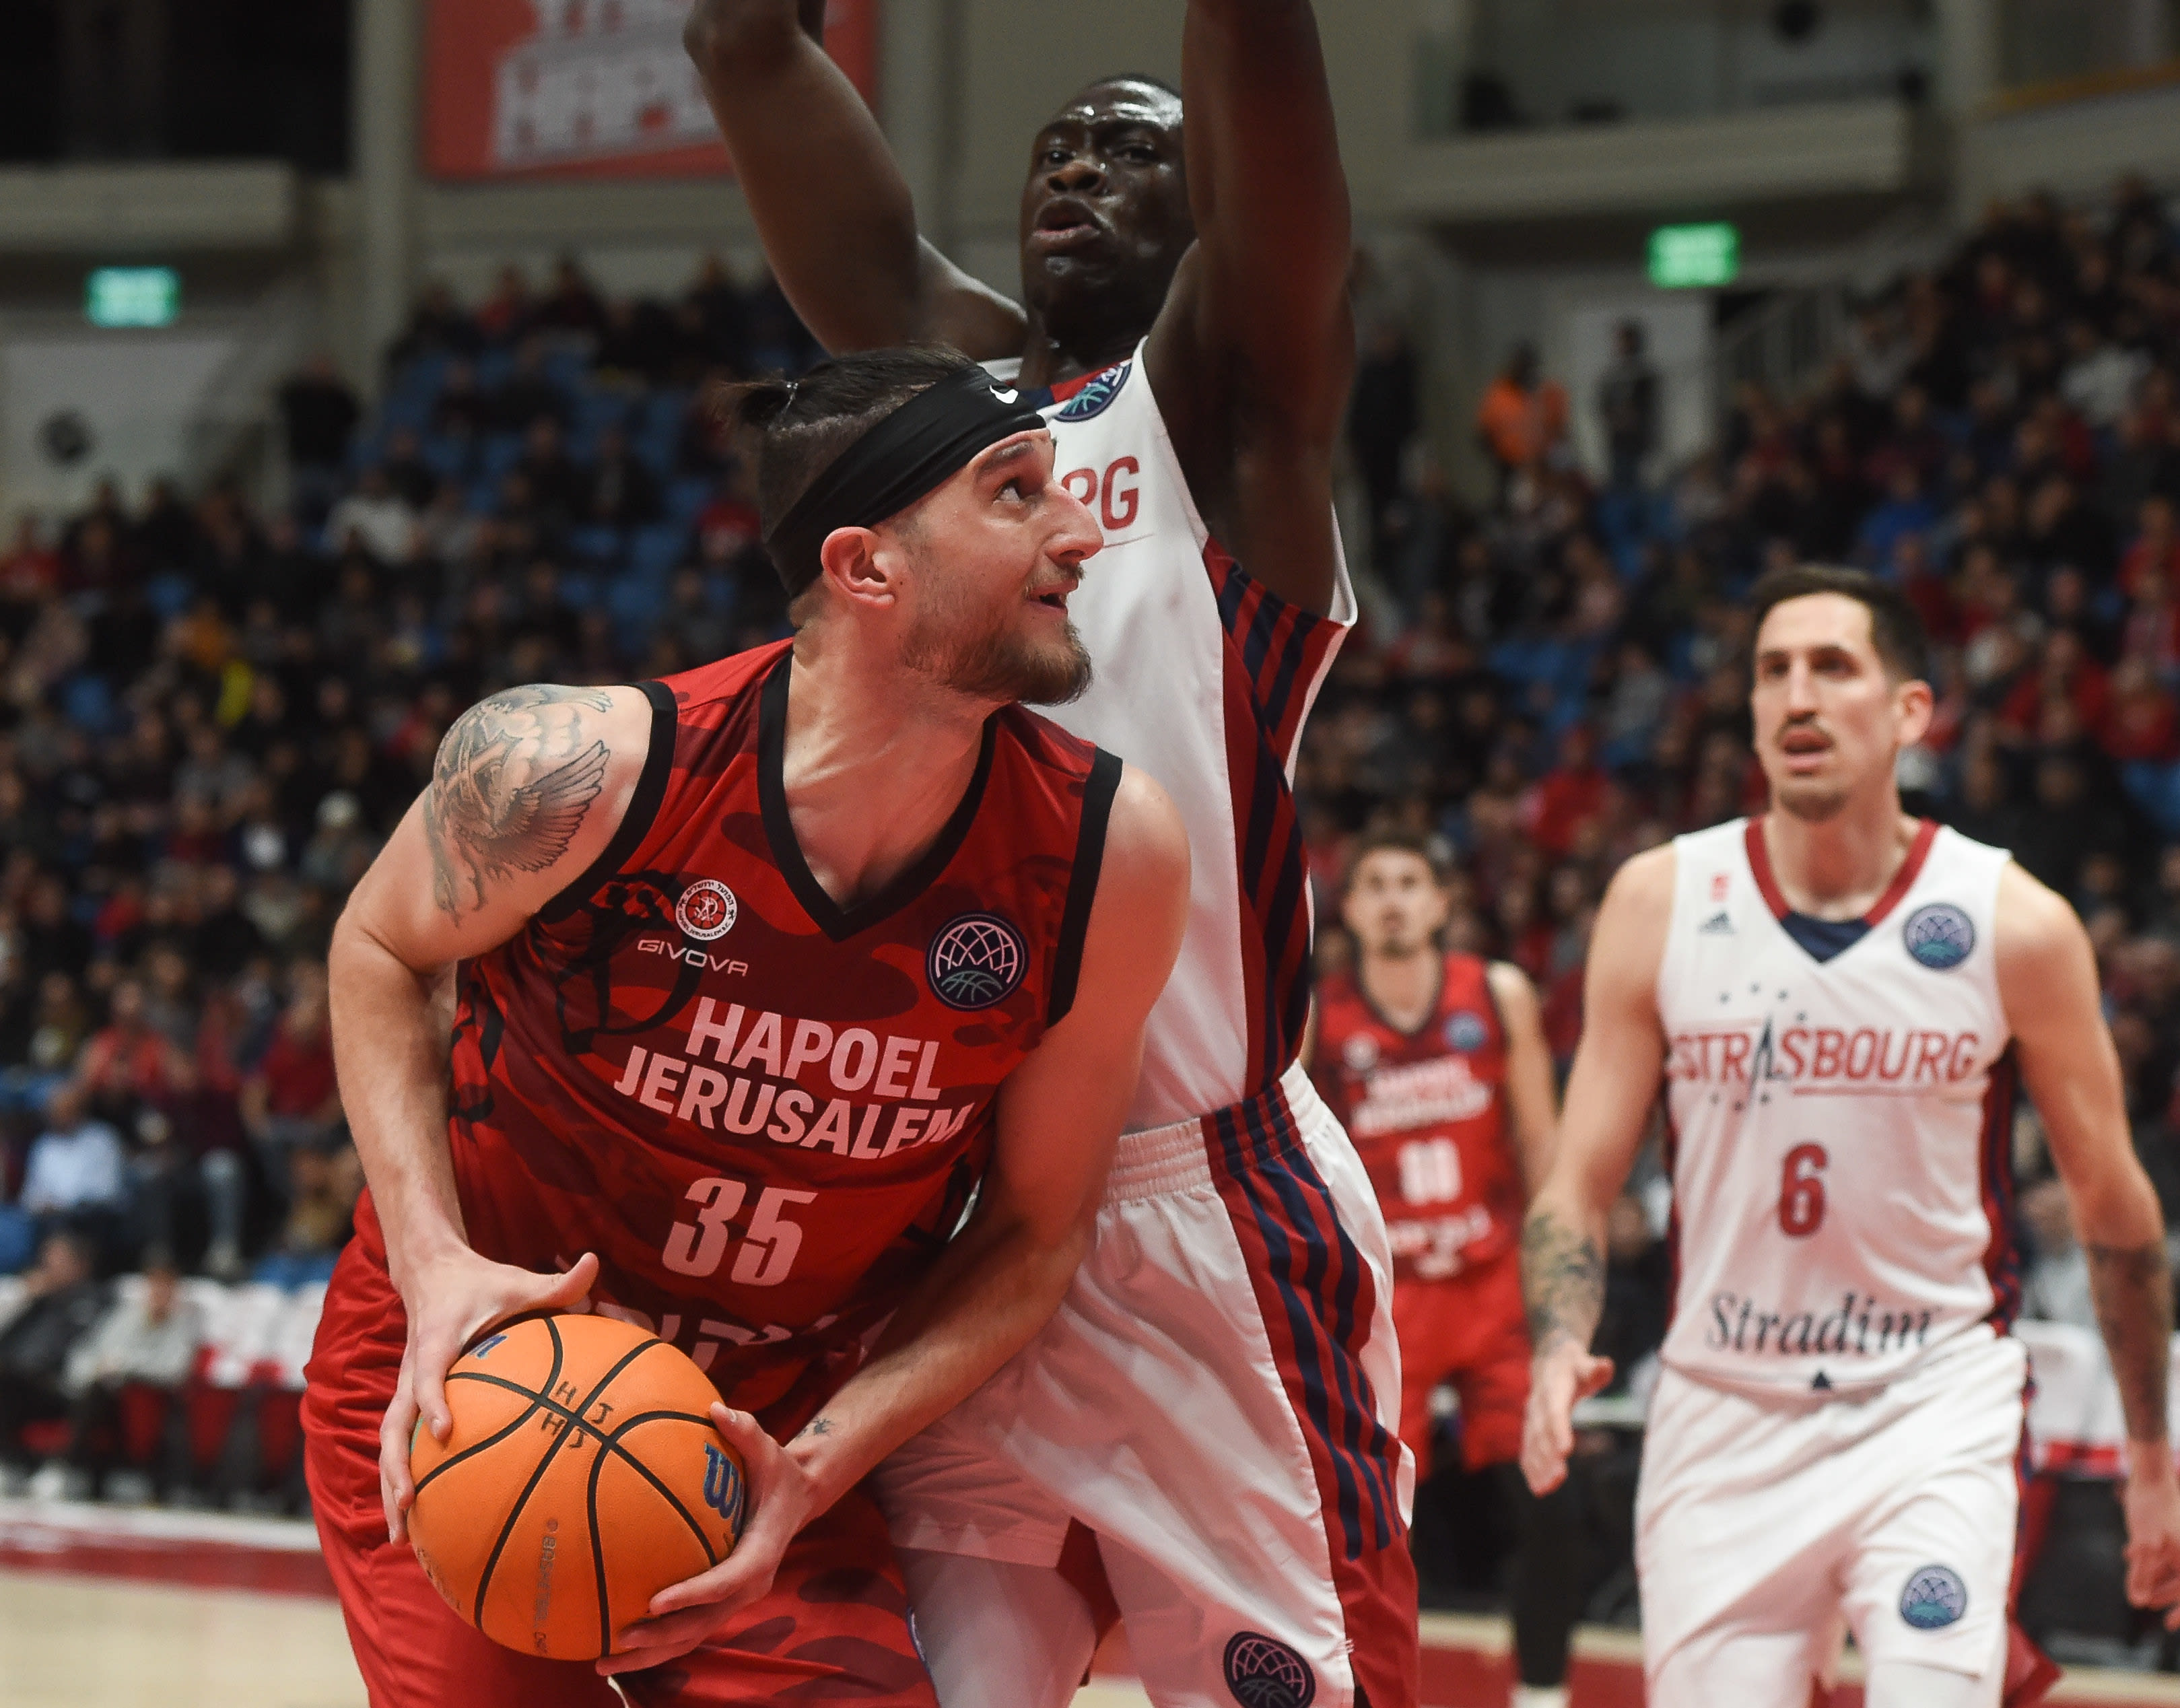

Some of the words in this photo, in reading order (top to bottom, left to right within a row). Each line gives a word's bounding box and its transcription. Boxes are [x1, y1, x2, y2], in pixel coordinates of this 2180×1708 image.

[637, 939, 749, 977] GIVOVA
[685, 996, 940, 1101] HAPOEL
[613, 1044, 975, 1159] JERUSALEM
[662, 1177, 818, 1287] 35
[1778, 1142, 1829, 1237] 6
[1706, 1290, 1939, 1355] Stradim
